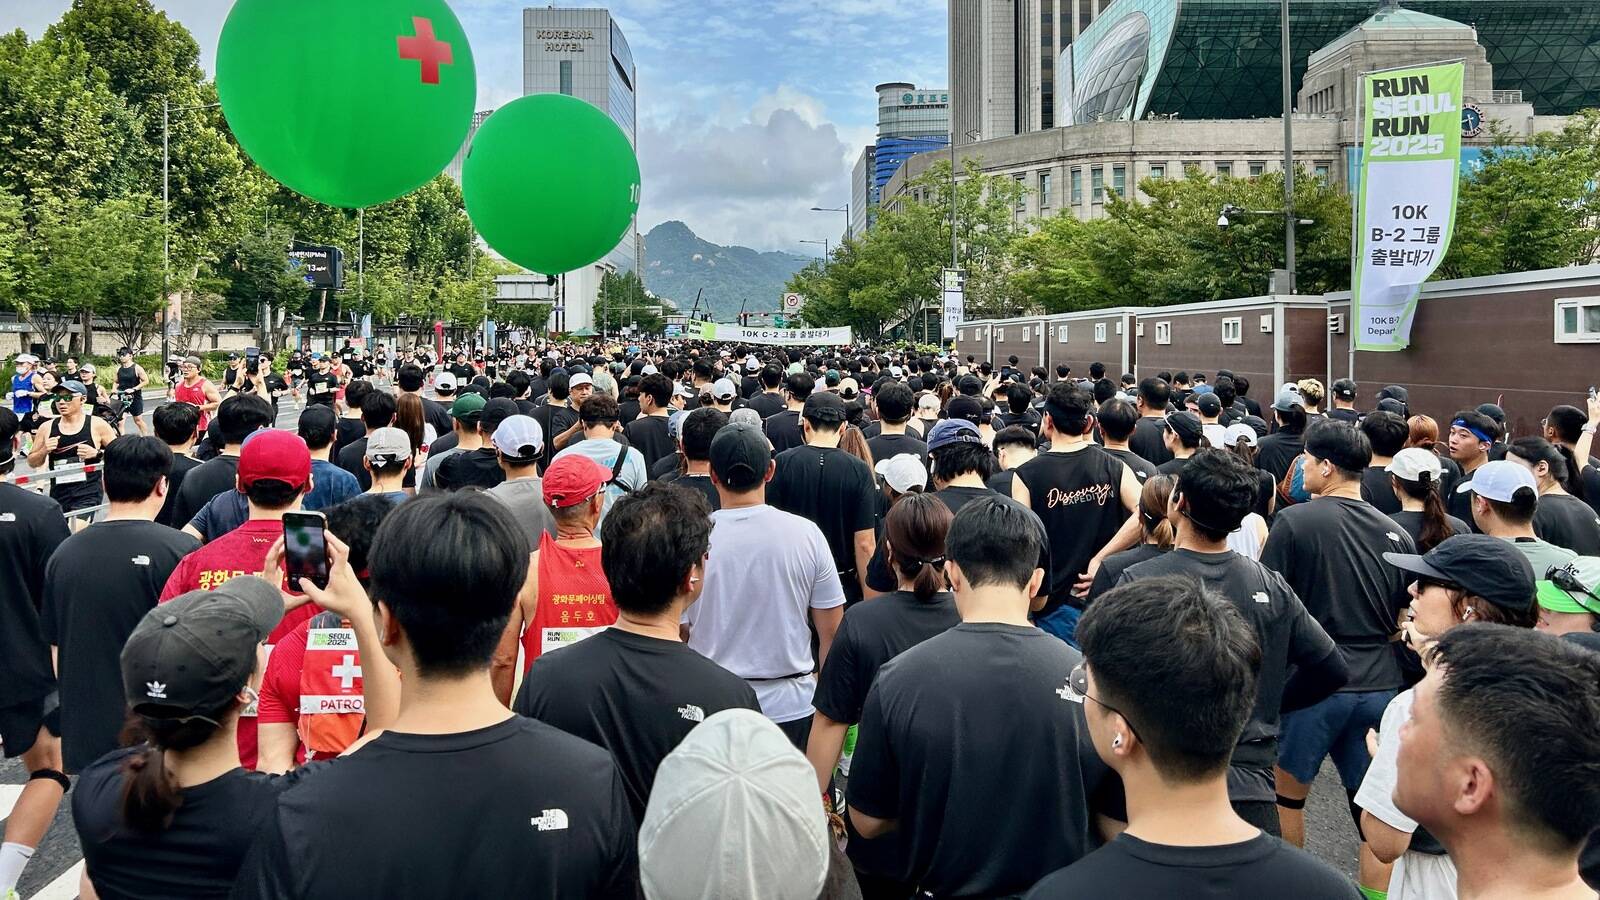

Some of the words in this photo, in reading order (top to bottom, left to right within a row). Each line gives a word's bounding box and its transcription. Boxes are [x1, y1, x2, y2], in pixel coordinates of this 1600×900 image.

[536, 30, 595, 40] KOREANA
[545, 42, 584, 52] HOTEL
[1372, 75, 1429, 97] RUN
[1372, 92, 1456, 118] SEOUL
[1372, 115, 1430, 137] RUN
[1369, 134, 1444, 156] 2025
[1392, 205, 1429, 219] 10K
[1371, 228, 1406, 242] B-2
[1410, 226, 1440, 244] 그룹
[1371, 249, 1435, 267] 출발대기
[1371, 317, 1388, 325] 10K
[742, 330, 759, 338] 10K
[761, 330, 779, 338] C-2
[781, 331, 797, 339] 그룹
[800, 330, 830, 339] 출발대기
[1047, 483, 1111, 508] Discovery
[1063, 490, 1115, 506] EXPEDITN
[328, 632, 352, 640] SEOUL
[320, 699, 363, 710] PATRO
